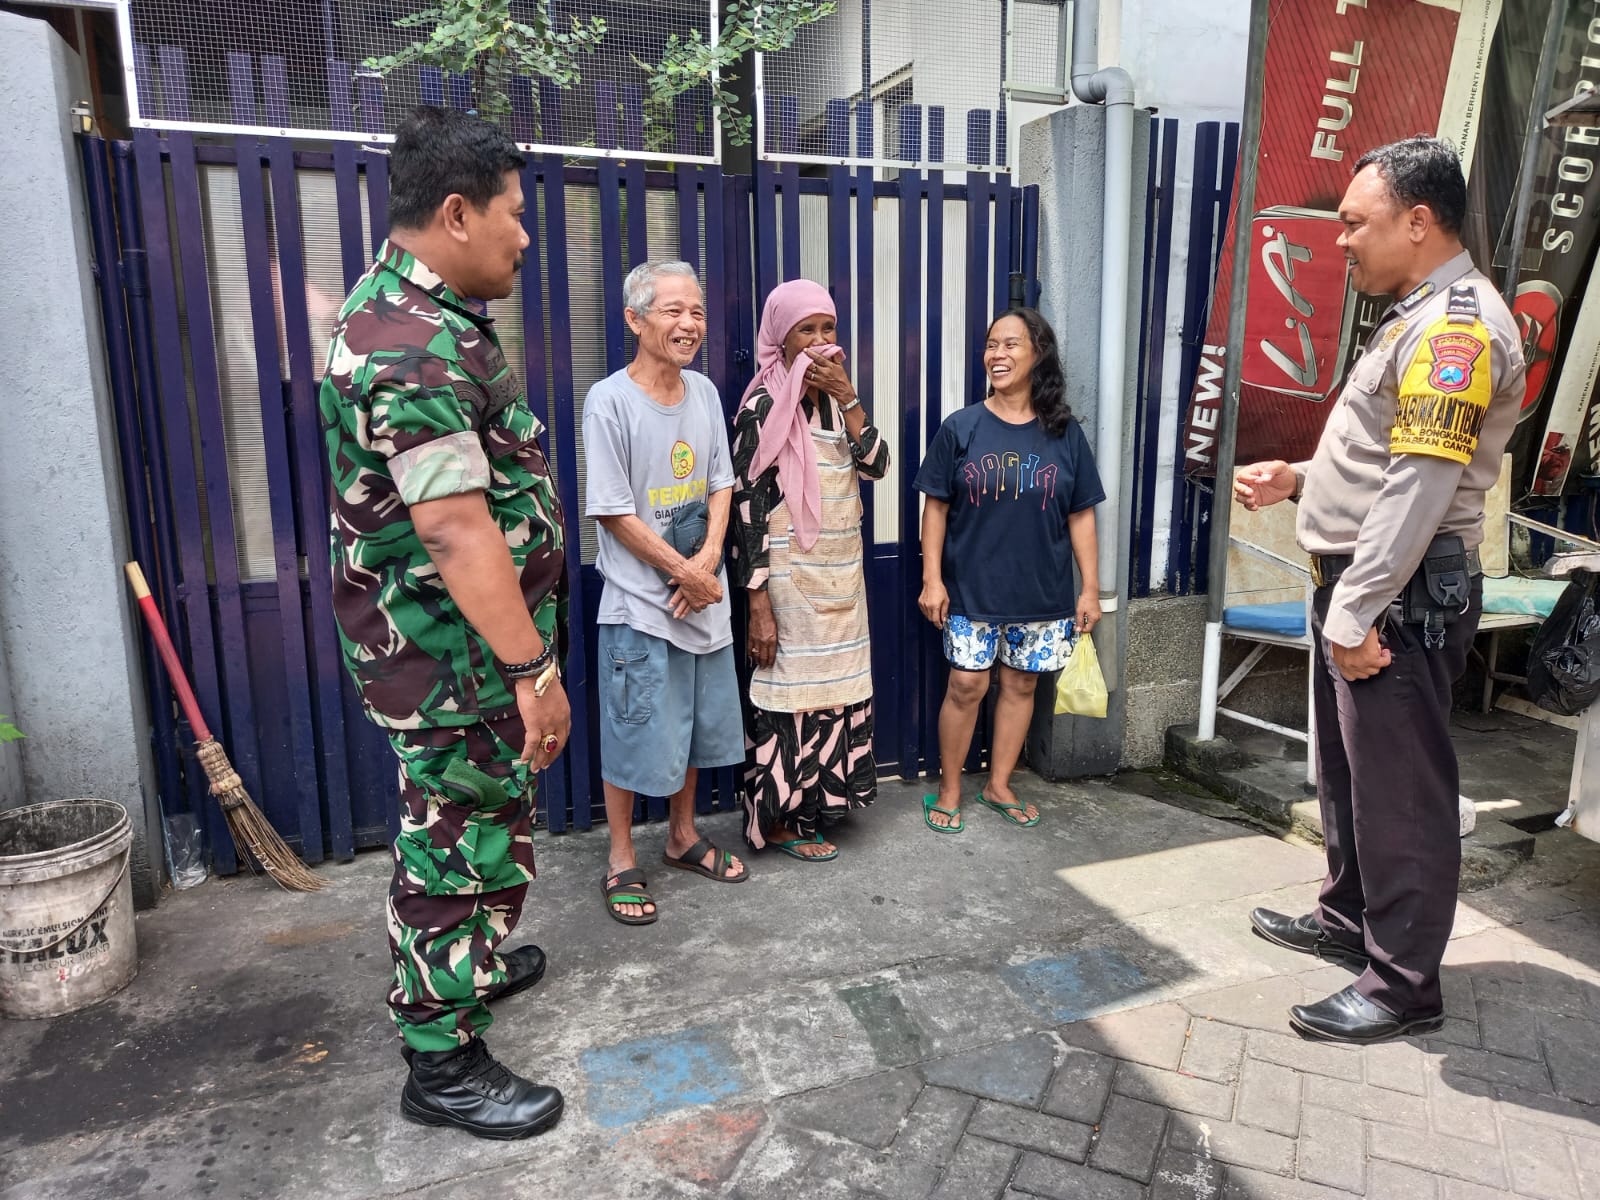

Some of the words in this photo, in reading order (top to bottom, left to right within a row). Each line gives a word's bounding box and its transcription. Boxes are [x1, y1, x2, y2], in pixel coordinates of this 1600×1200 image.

[1310, 40, 1364, 162] FULL
[1459, 120, 1471, 162] LAYANAN
[1465, 71, 1481, 119] BERHENTI
[1186, 343, 1227, 463] NEW!
[1577, 381, 1591, 413] KARENA
[1419, 428, 1473, 446] BONGKARAN
[38, 916, 84, 935] EMULSION
[24, 957, 74, 973] COLOUR
